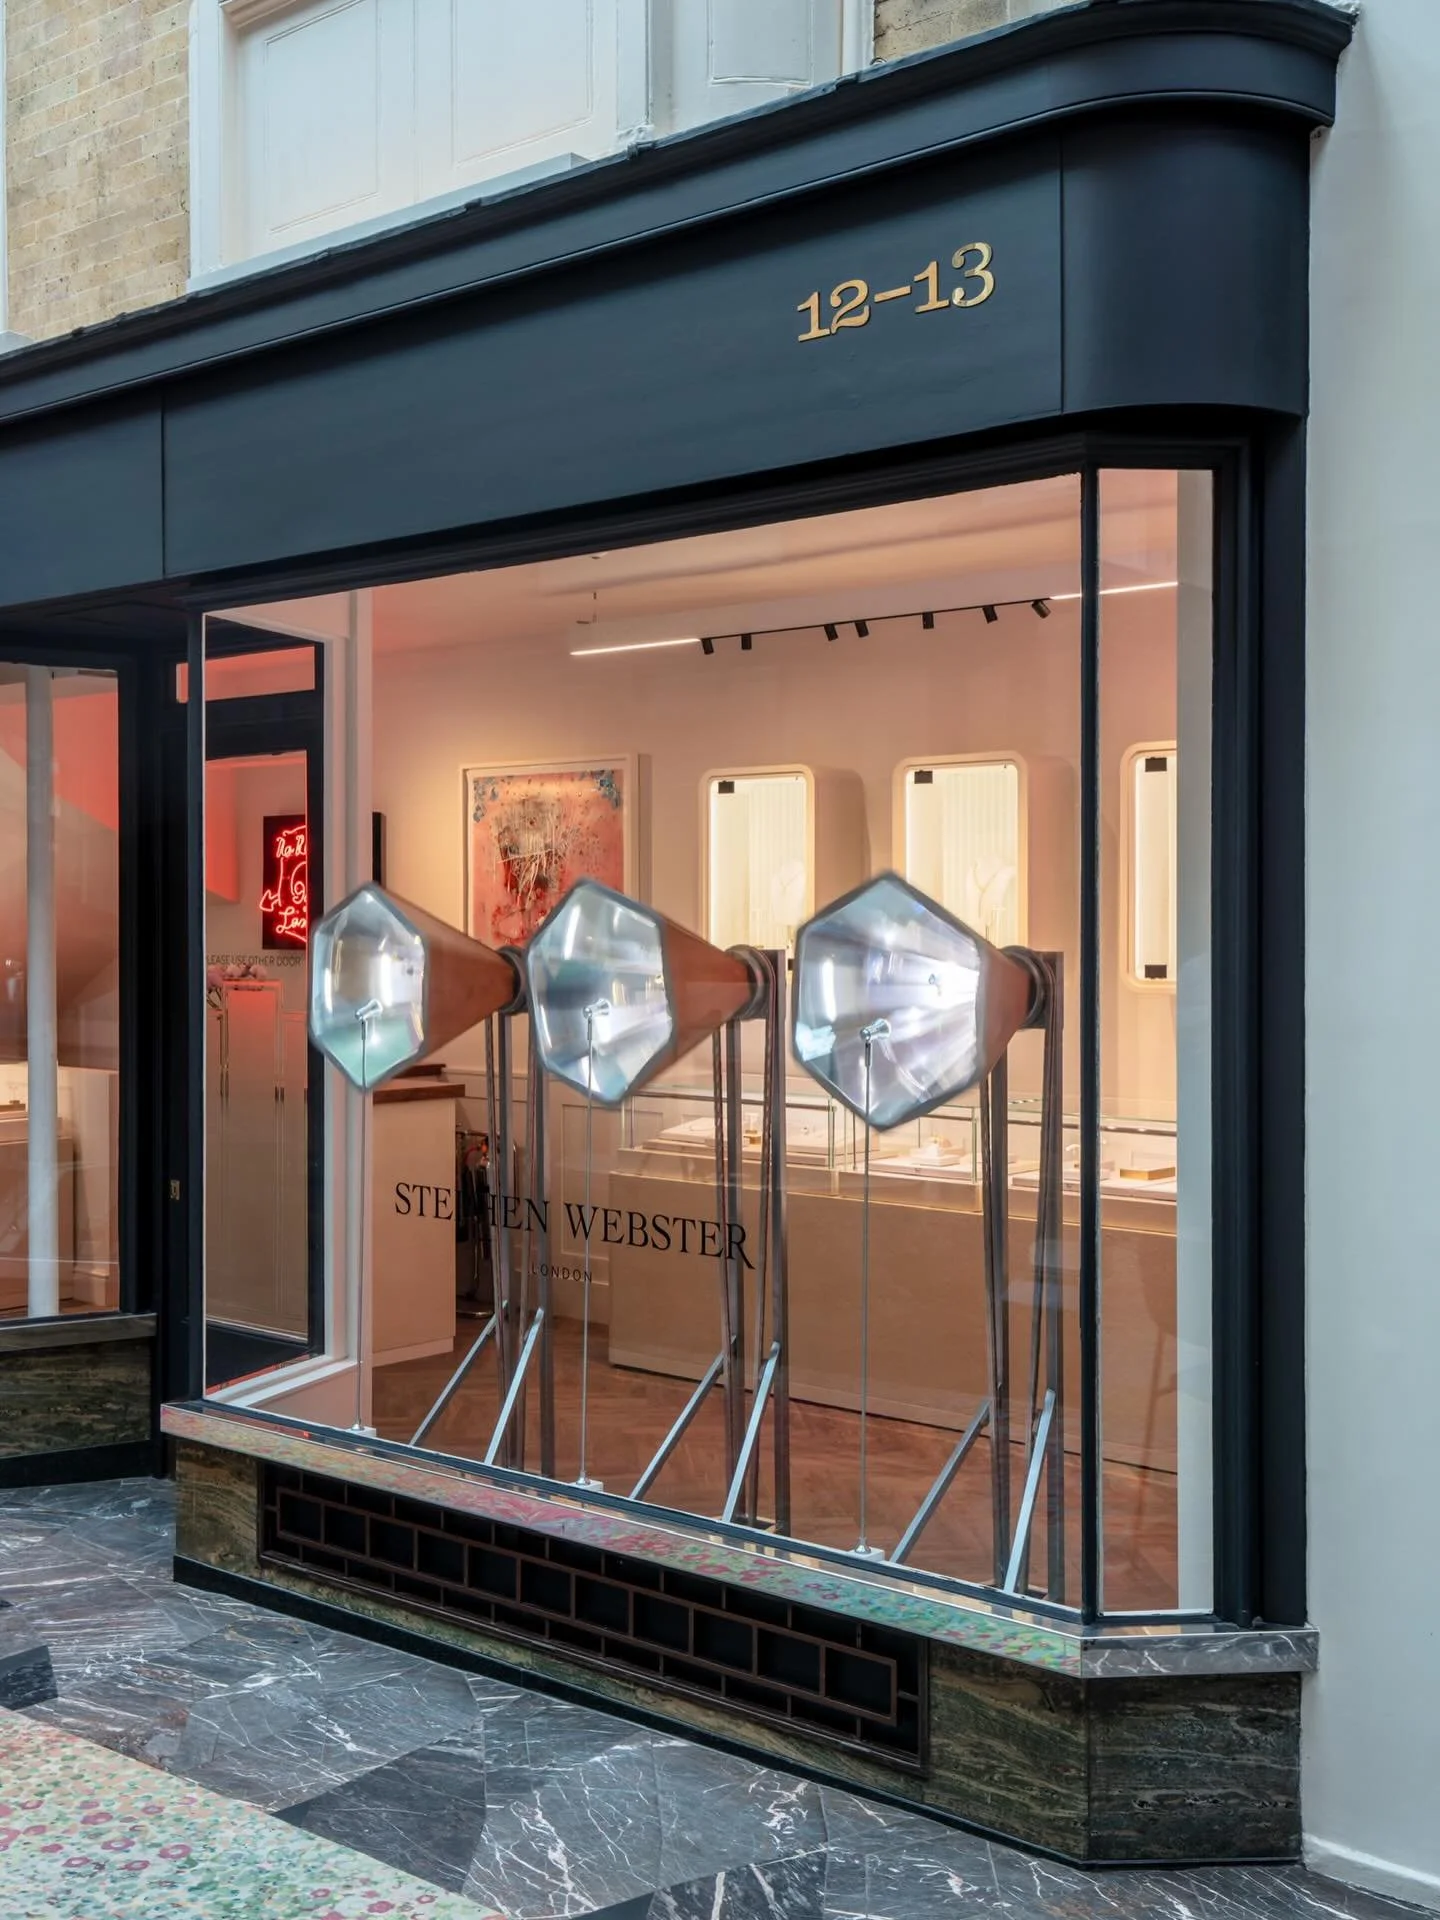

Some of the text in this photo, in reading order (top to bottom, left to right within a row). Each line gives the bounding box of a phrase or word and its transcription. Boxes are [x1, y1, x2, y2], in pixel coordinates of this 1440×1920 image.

[797, 241, 995, 342] 12-13
[206, 954, 301, 968] LEASE USE OTHER DOOR
[394, 1182, 756, 1270] STEHEN WEBSTER
[531, 1262, 593, 1283] LONDON
